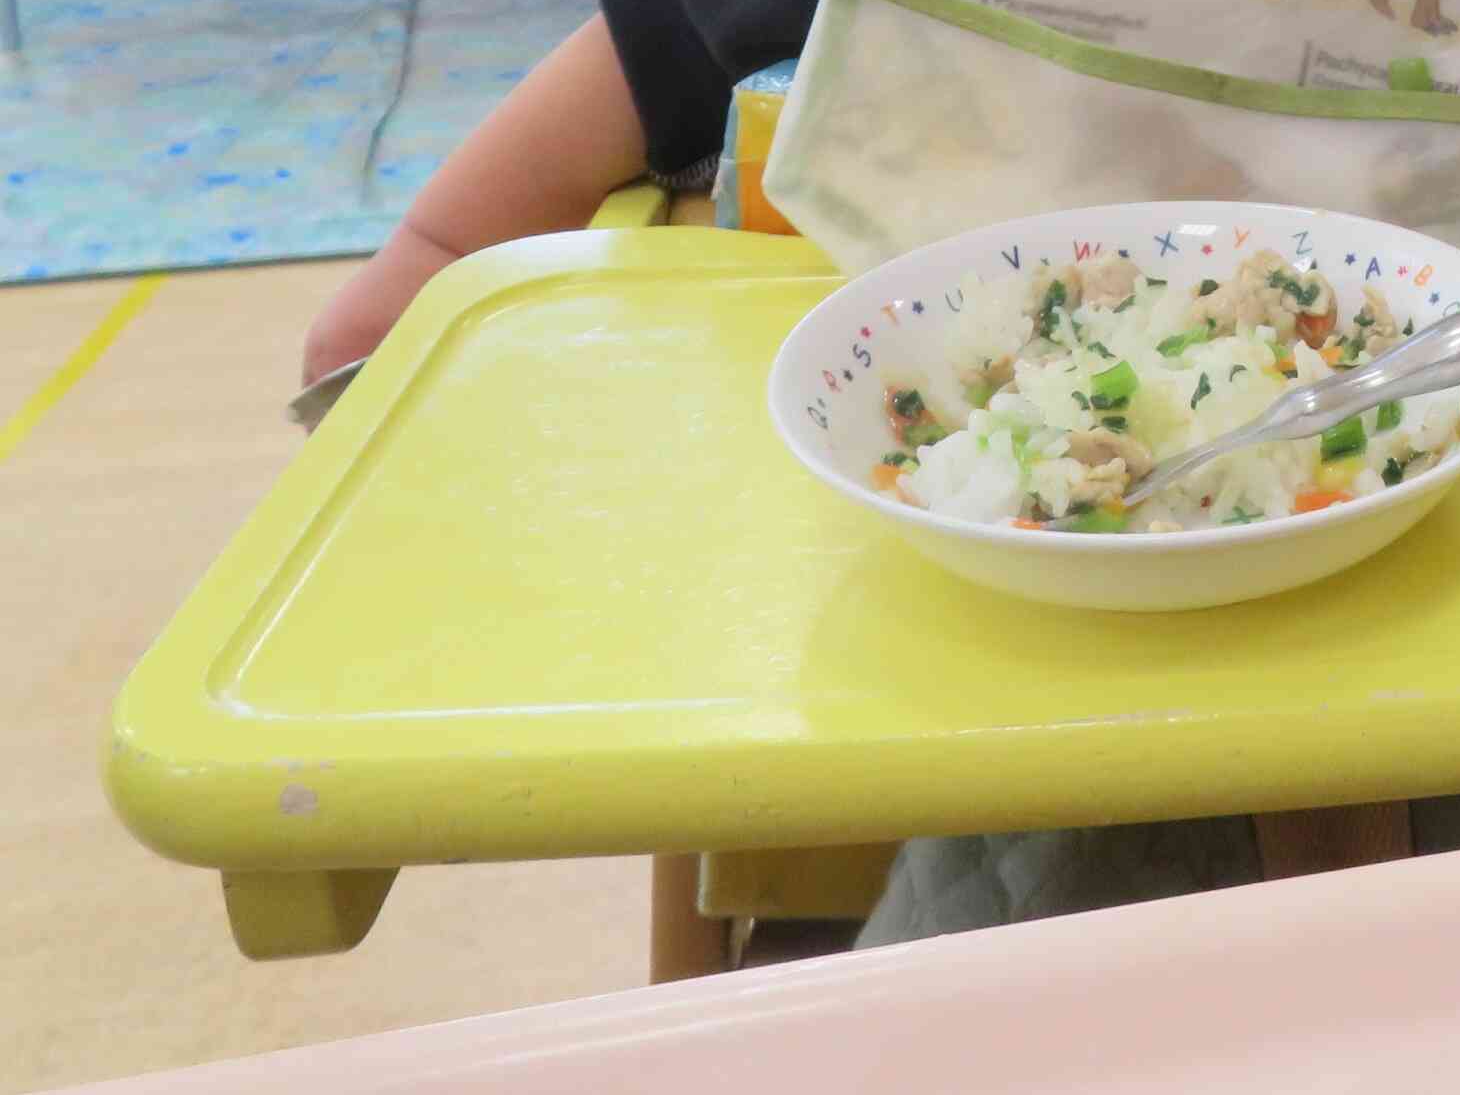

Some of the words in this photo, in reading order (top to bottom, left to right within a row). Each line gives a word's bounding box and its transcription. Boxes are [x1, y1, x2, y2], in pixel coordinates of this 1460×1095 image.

[852, 343, 872, 368] S
[1001, 245, 1021, 270] V
[1153, 231, 1179, 258] X
[1233, 225, 1251, 249] Y
[1291, 230, 1314, 256] Z
[1365, 257, 1382, 281] A
[1413, 264, 1435, 288] B
